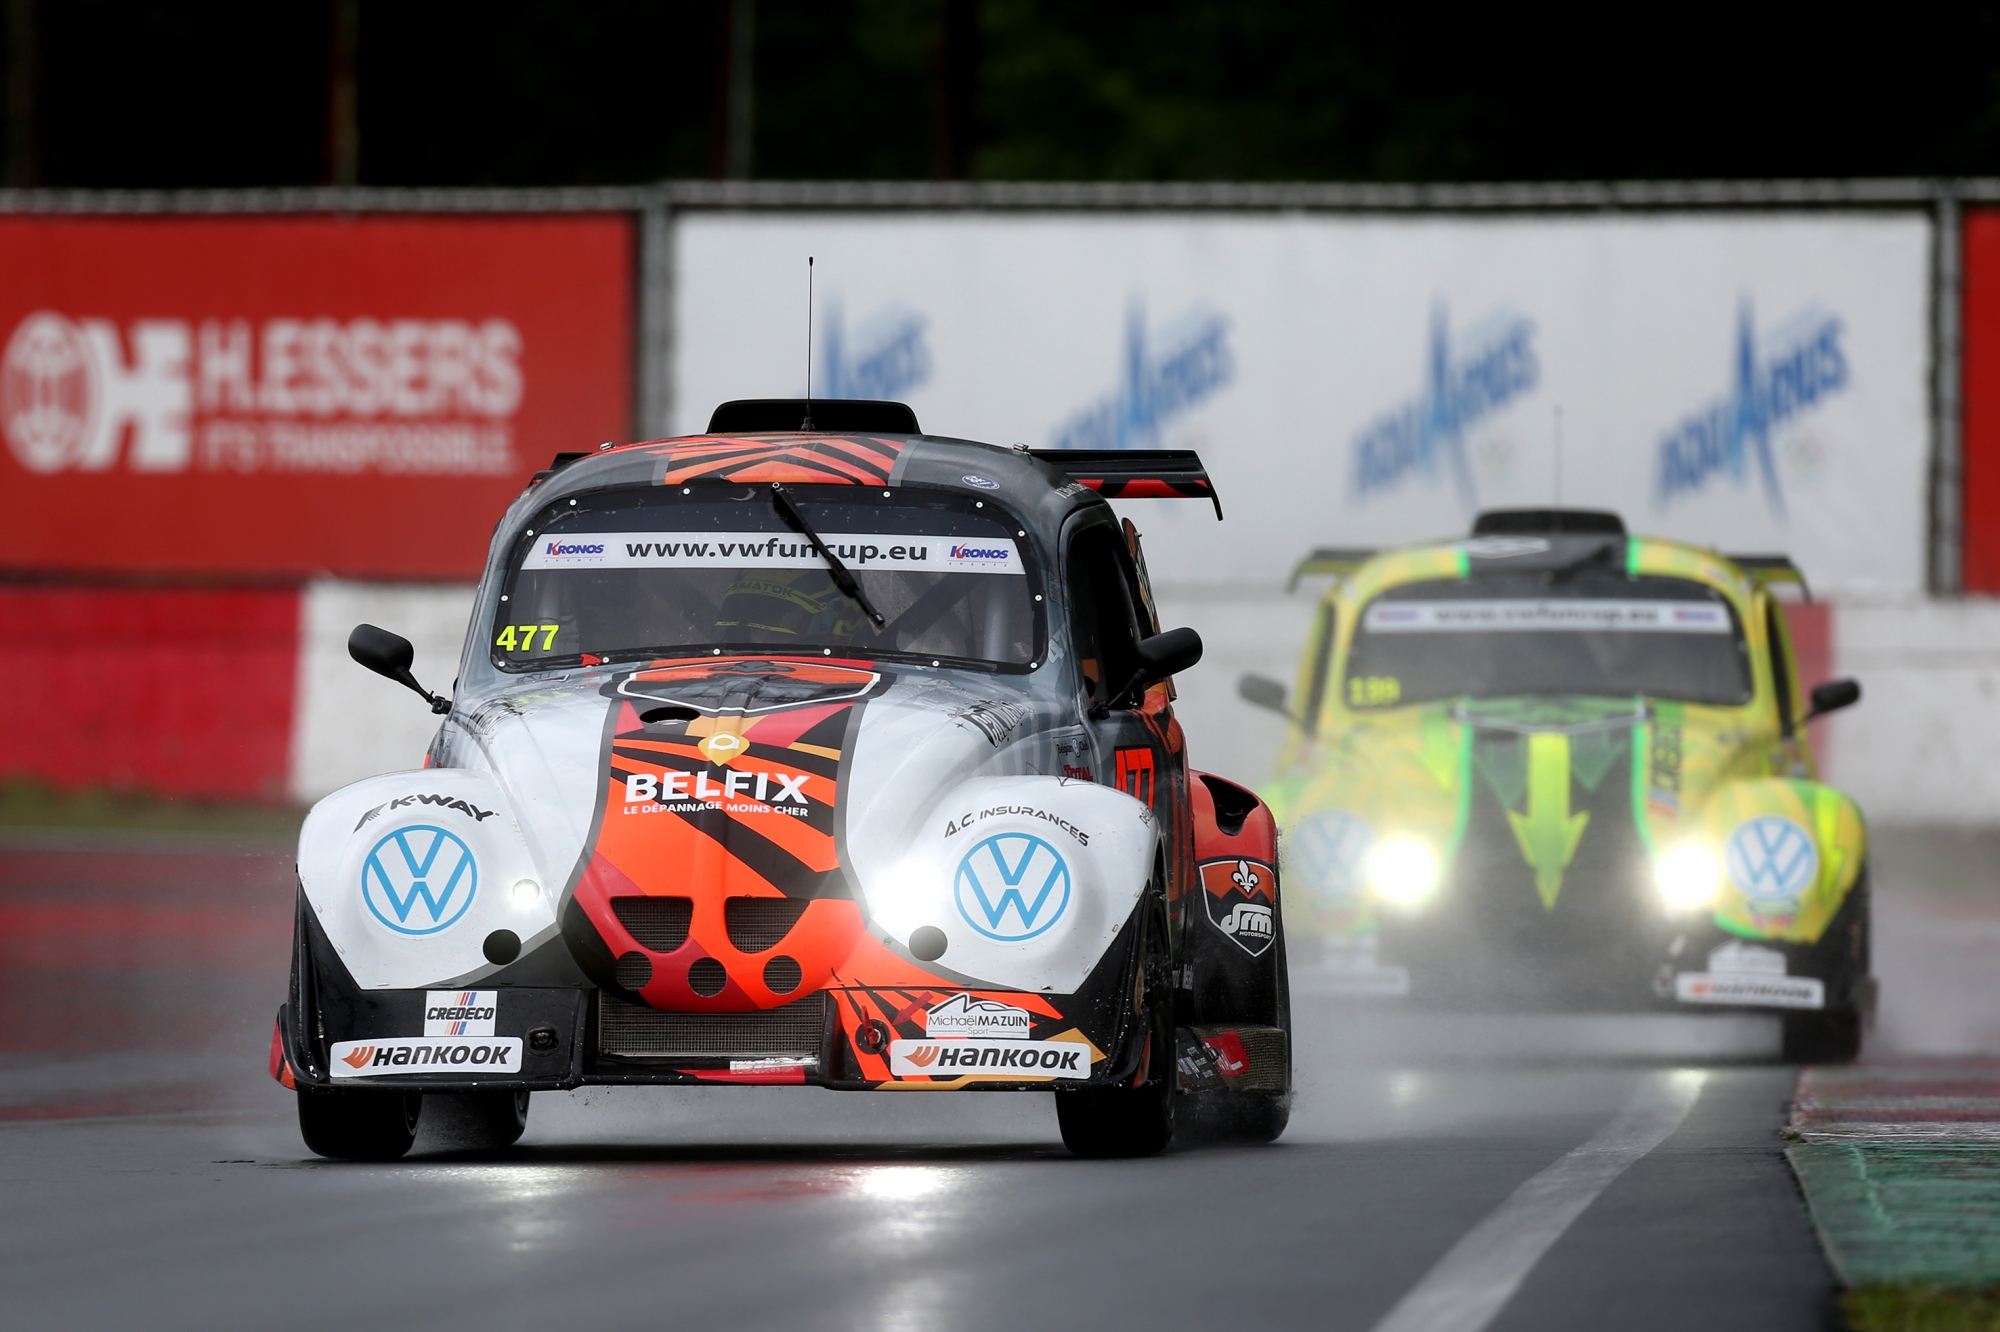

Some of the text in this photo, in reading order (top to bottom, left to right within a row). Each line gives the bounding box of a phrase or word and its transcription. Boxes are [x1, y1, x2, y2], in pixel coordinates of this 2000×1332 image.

[546, 540, 604, 556] KRONOS
[626, 538, 927, 563] www.vwfunup.eu
[950, 543, 1009, 559] KRONOS
[496, 624, 559, 651] 477
[625, 769, 811, 804] BELFIX
[624, 801, 809, 816] LE DÉPANNAGE MOINS CHER
[944, 806, 1089, 847] A.C. INSURANCES
[1239, 931, 1272, 940] MOTORSPORT
[426, 1007, 495, 1020] CREDECO
[967, 1027, 989, 1035] Sport
